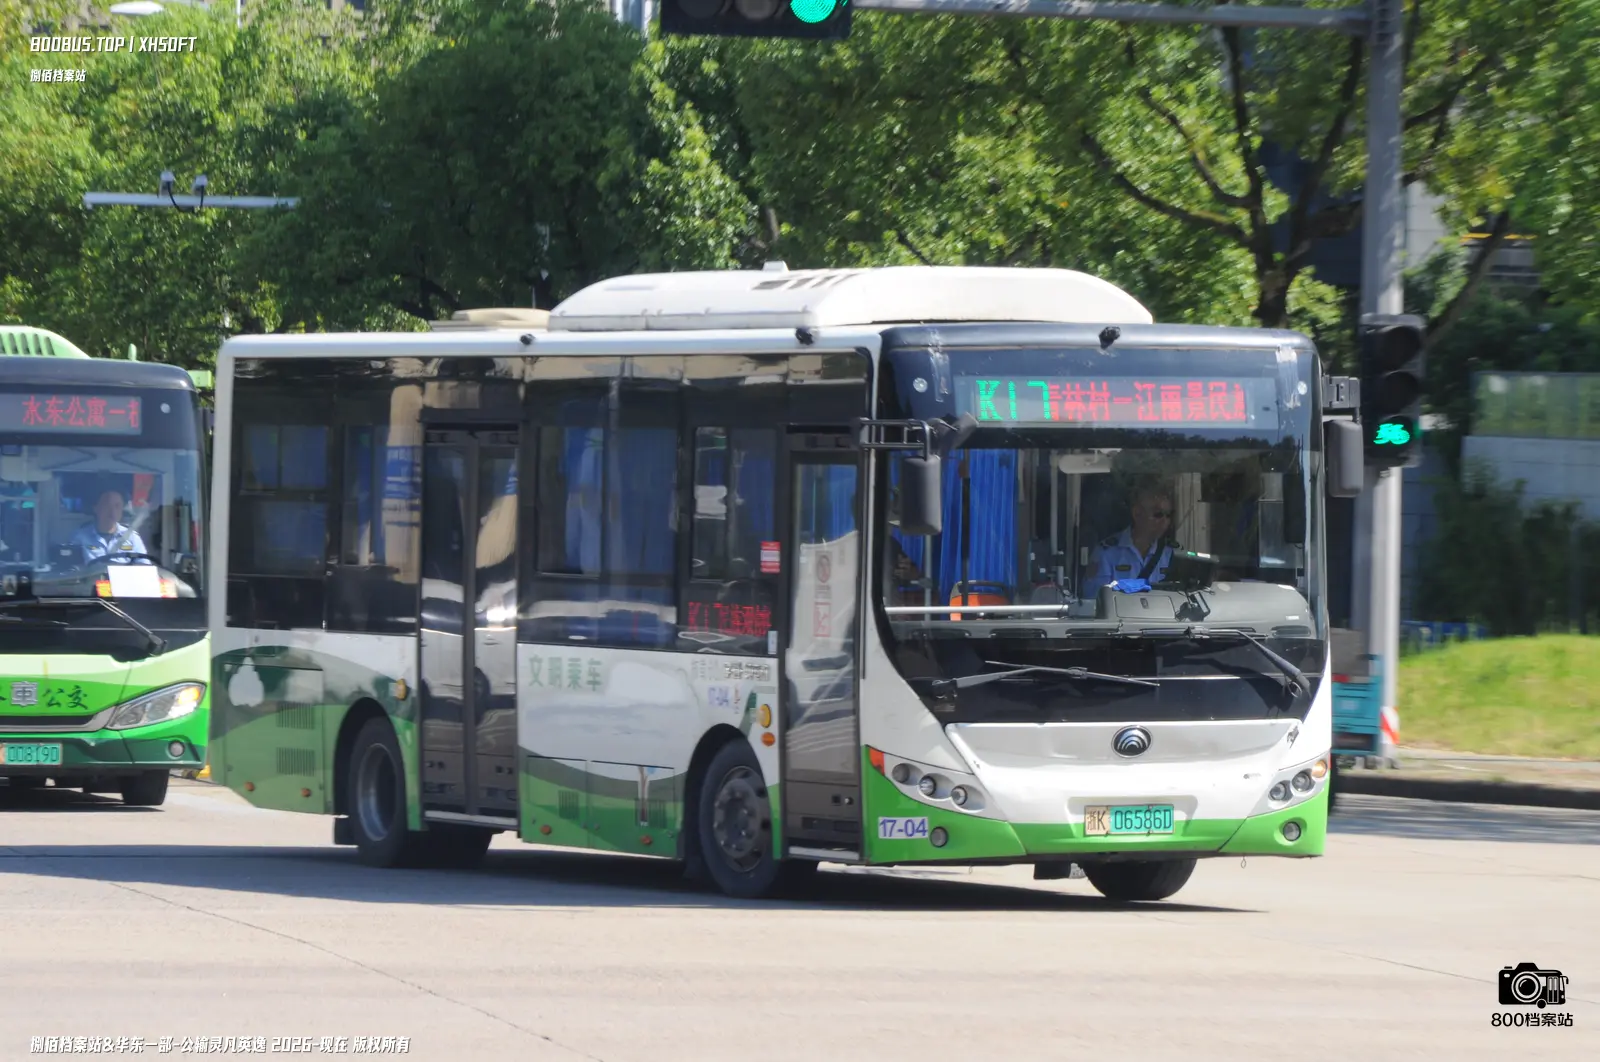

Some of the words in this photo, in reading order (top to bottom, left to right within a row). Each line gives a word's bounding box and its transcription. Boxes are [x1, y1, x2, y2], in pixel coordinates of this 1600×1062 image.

[976, 380, 1051, 421] K17
[880, 818, 928, 838] 17-04
[1114, 809, 1173, 830] 06586D
